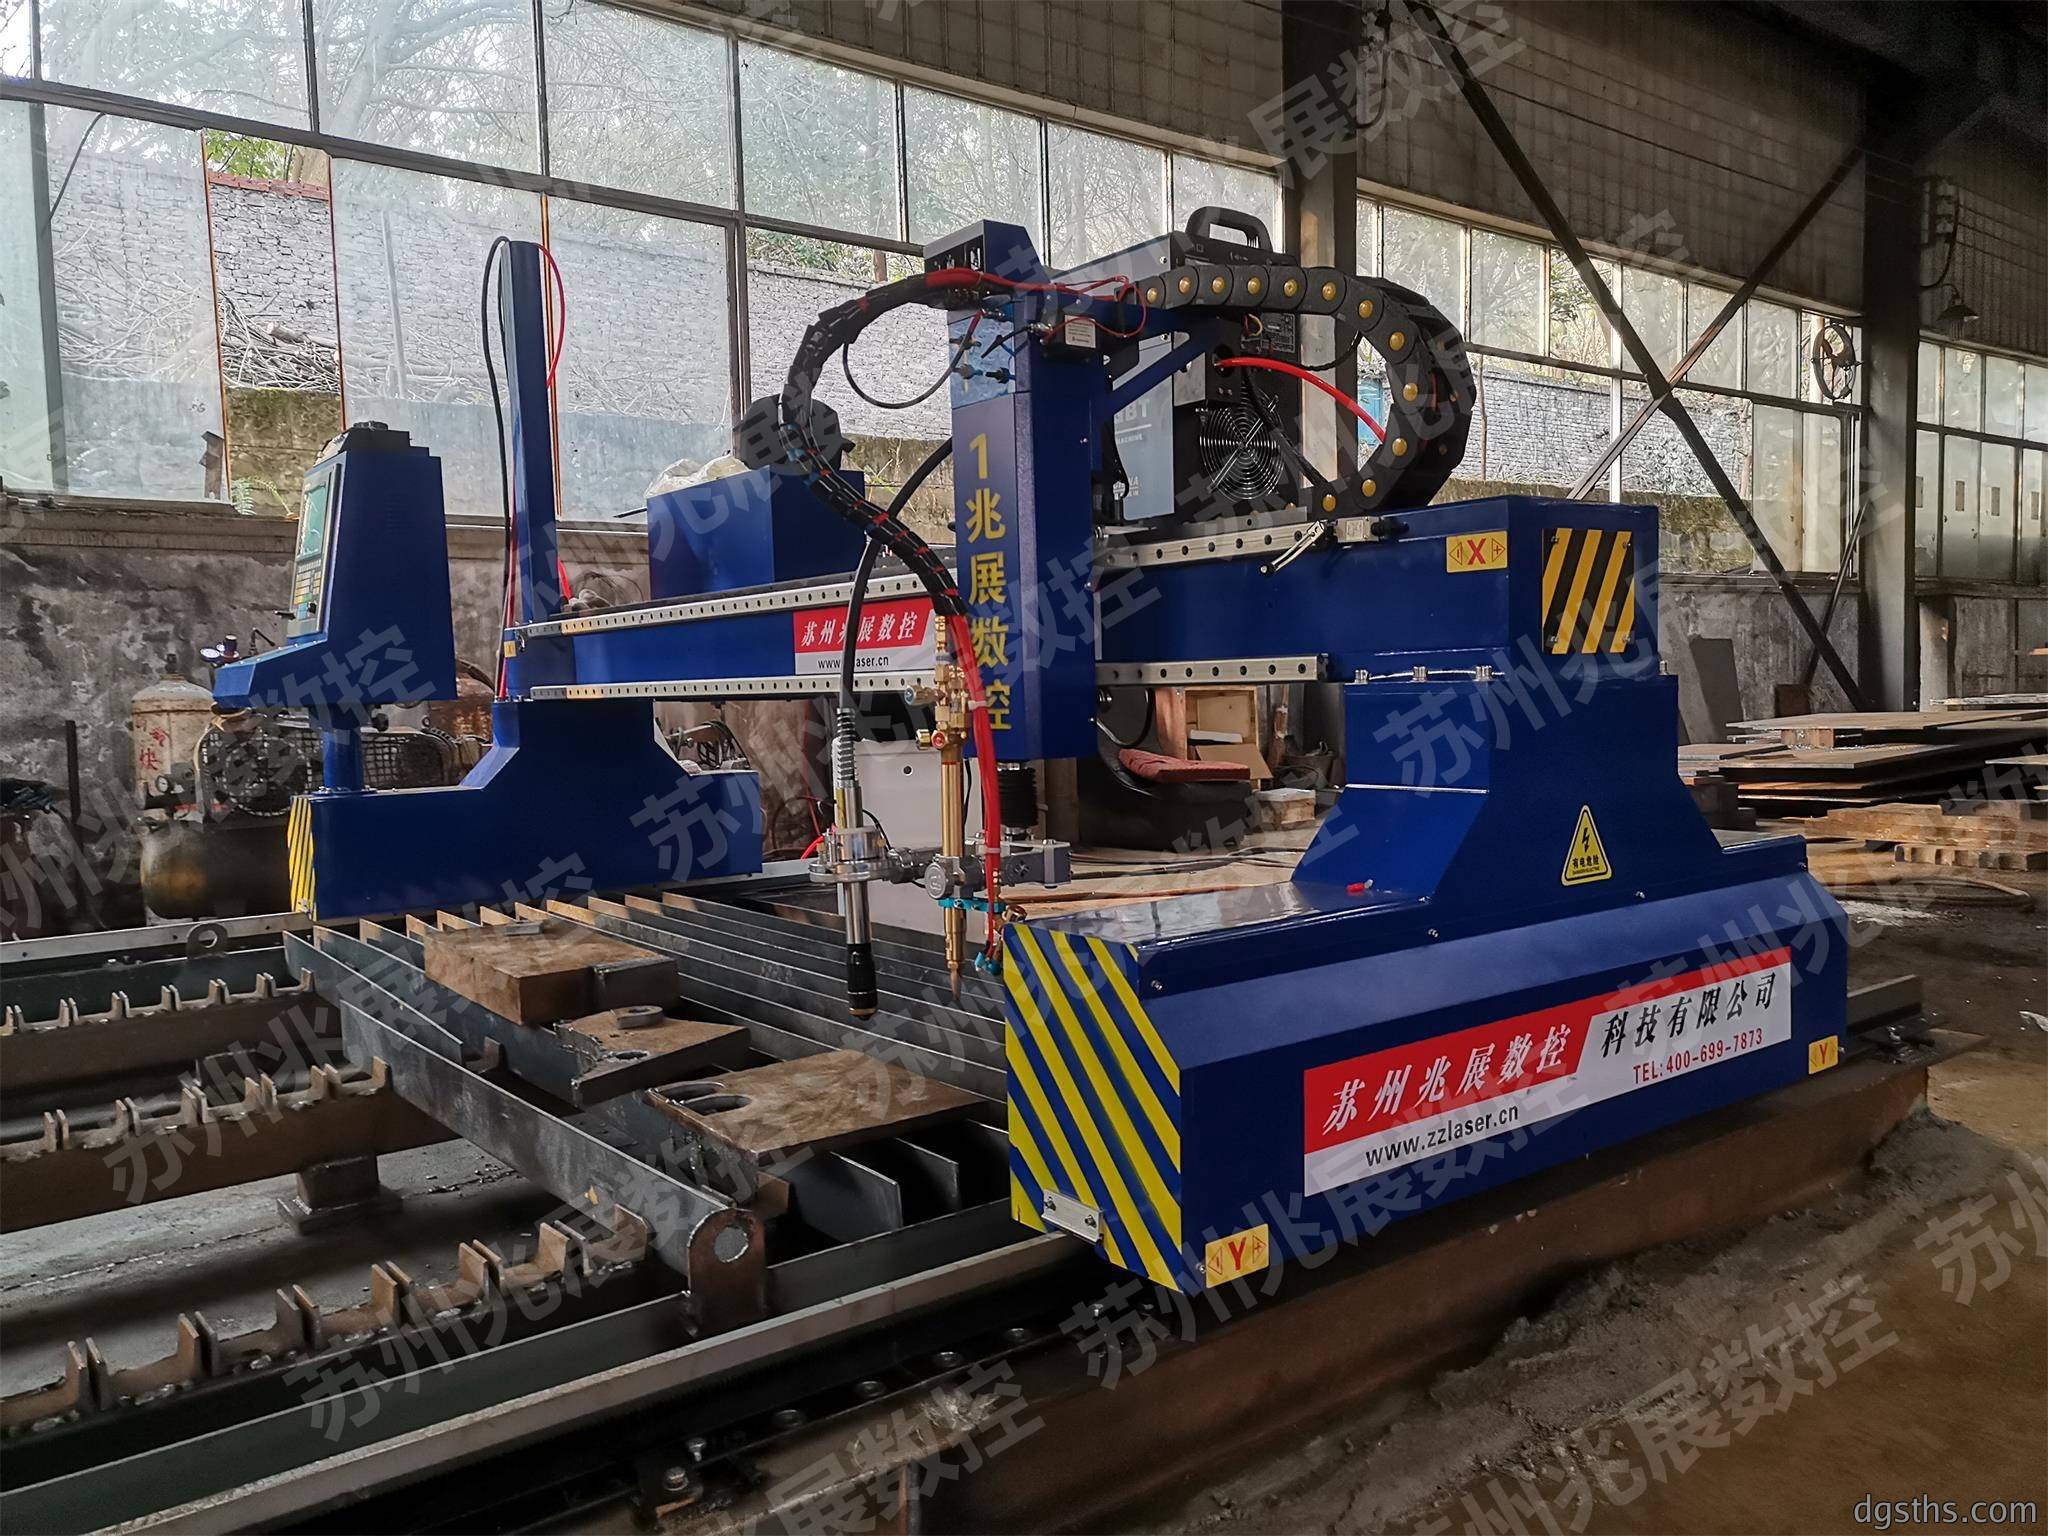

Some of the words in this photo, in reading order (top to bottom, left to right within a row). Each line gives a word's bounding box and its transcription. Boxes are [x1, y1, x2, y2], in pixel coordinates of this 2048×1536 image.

[1467, 538, 1487, 566] X
[817, 655, 890, 669] wwwaser.cn
[1322, 1023, 1571, 1136] 苏州兆展数控
[1601, 972, 1776, 1059] 科技有限公司
[1818, 1042, 1829, 1066] Y
[1365, 1104, 1519, 1167] www.zzlaser.cn
[1227, 1236, 1248, 1272] Y
